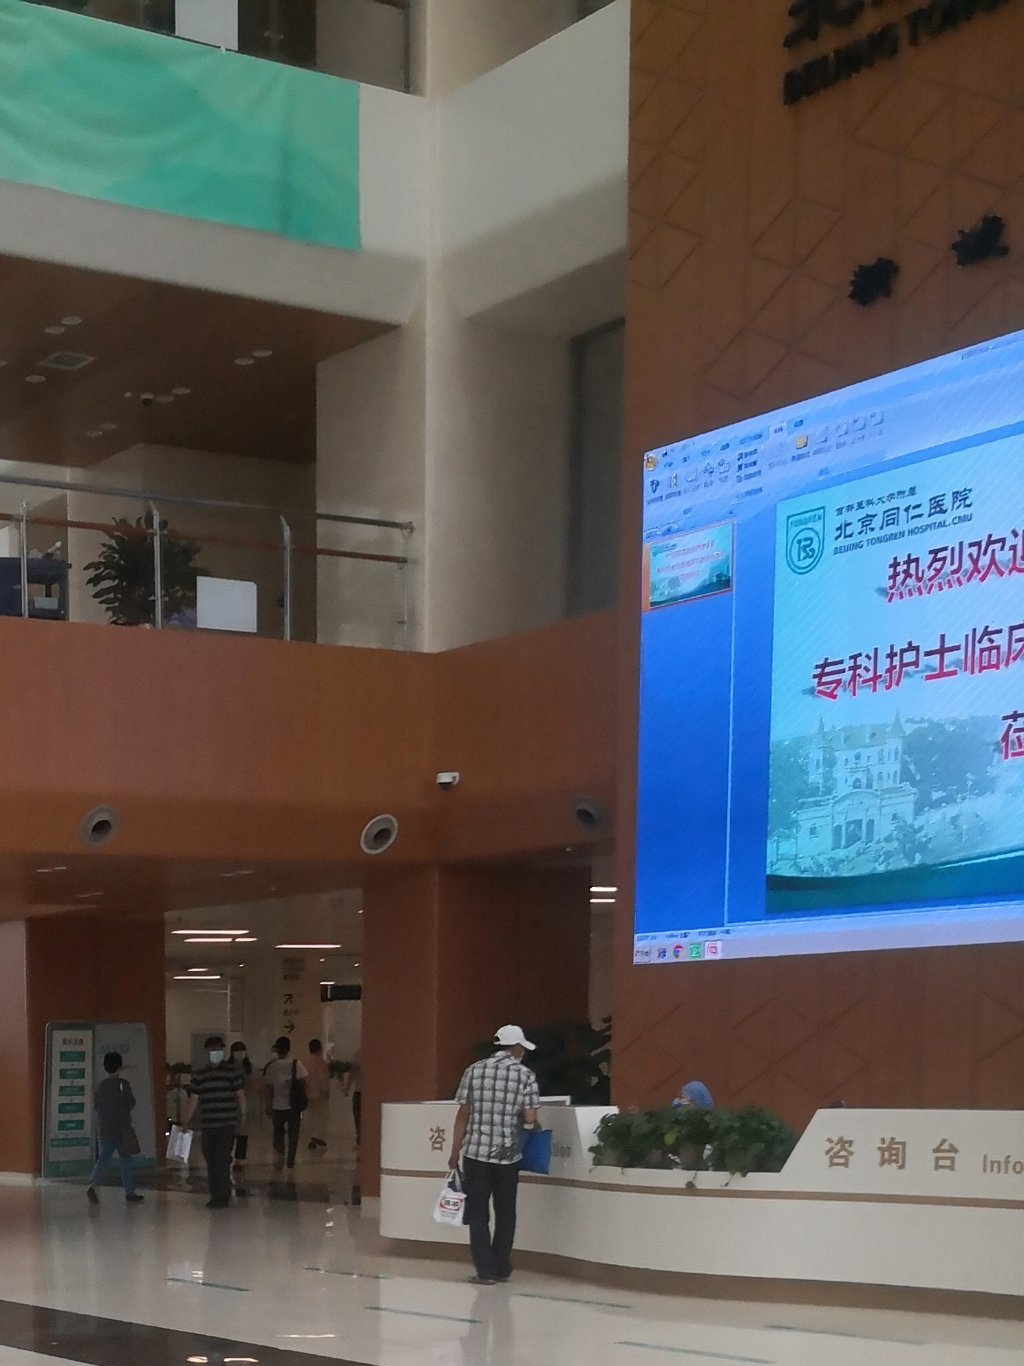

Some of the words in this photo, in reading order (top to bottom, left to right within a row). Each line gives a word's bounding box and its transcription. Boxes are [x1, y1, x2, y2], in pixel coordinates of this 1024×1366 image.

[834, 487, 973, 541] 北京同仁医院
[833, 540, 864, 556] BEIJING
[866, 530, 906, 547] TONGREN
[824, 1135, 960, 1171] 咨询台
